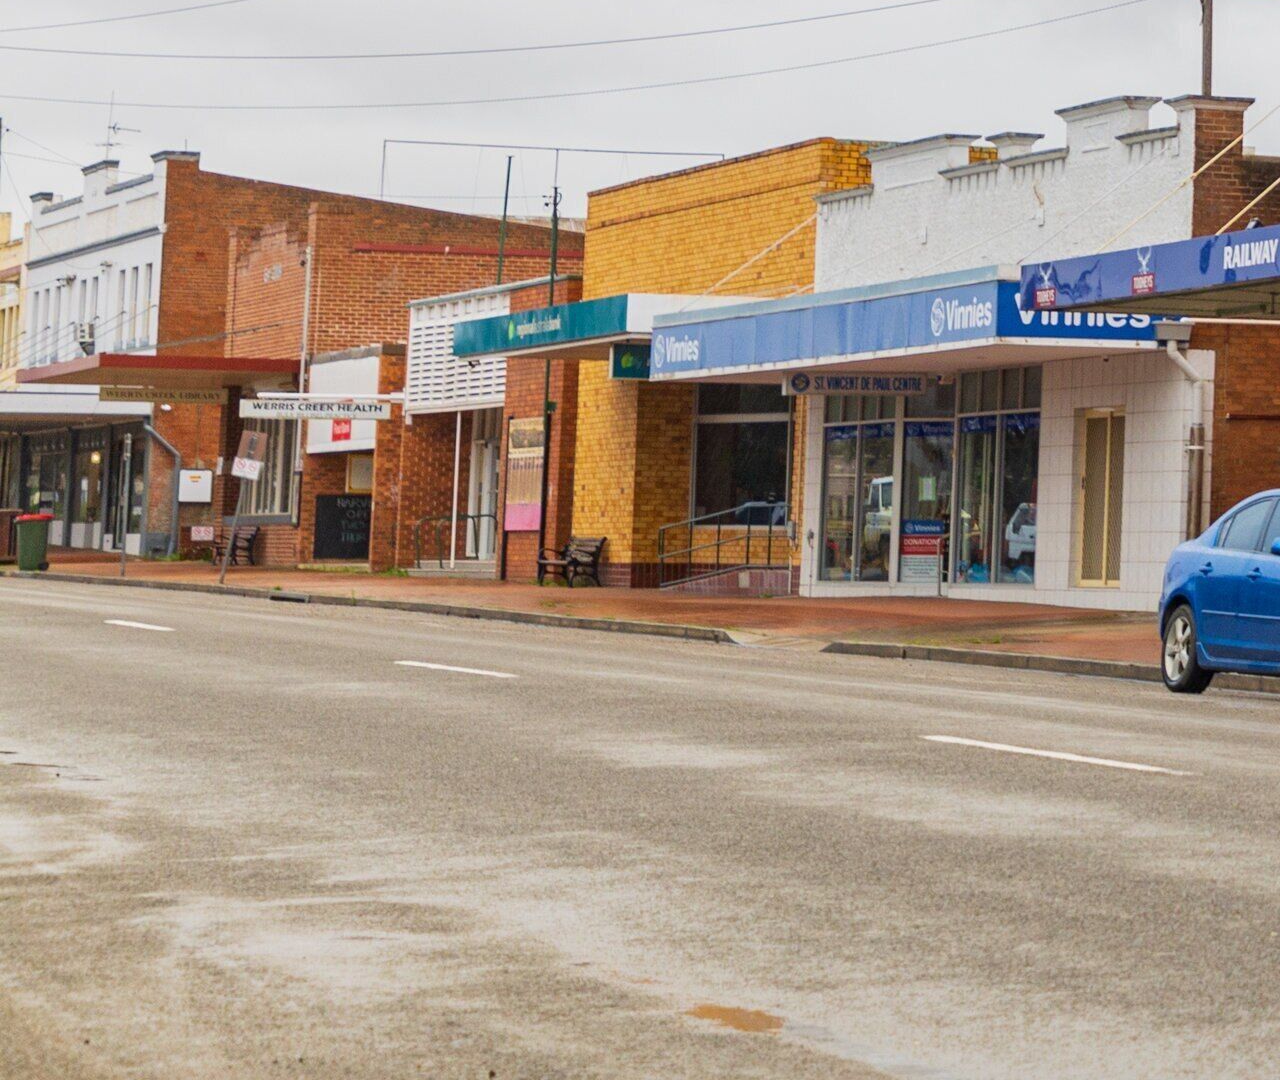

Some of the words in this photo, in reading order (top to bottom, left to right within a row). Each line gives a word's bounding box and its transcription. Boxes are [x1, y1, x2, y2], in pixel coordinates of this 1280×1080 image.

[1223, 239, 1279, 270] RAILWAY
[946, 297, 993, 331] Vinnies
[666, 336, 699, 363] Vinnies
[827, 376, 859, 390] VINCENT
[861, 376, 871, 390] DE
[872, 376, 891, 391] PAUL
[893, 376, 922, 391] CENTRE
[252, 402, 295, 411] WERRIS
[298, 402, 334, 412] CREEK
[337, 403, 383, 412] HEALTH
